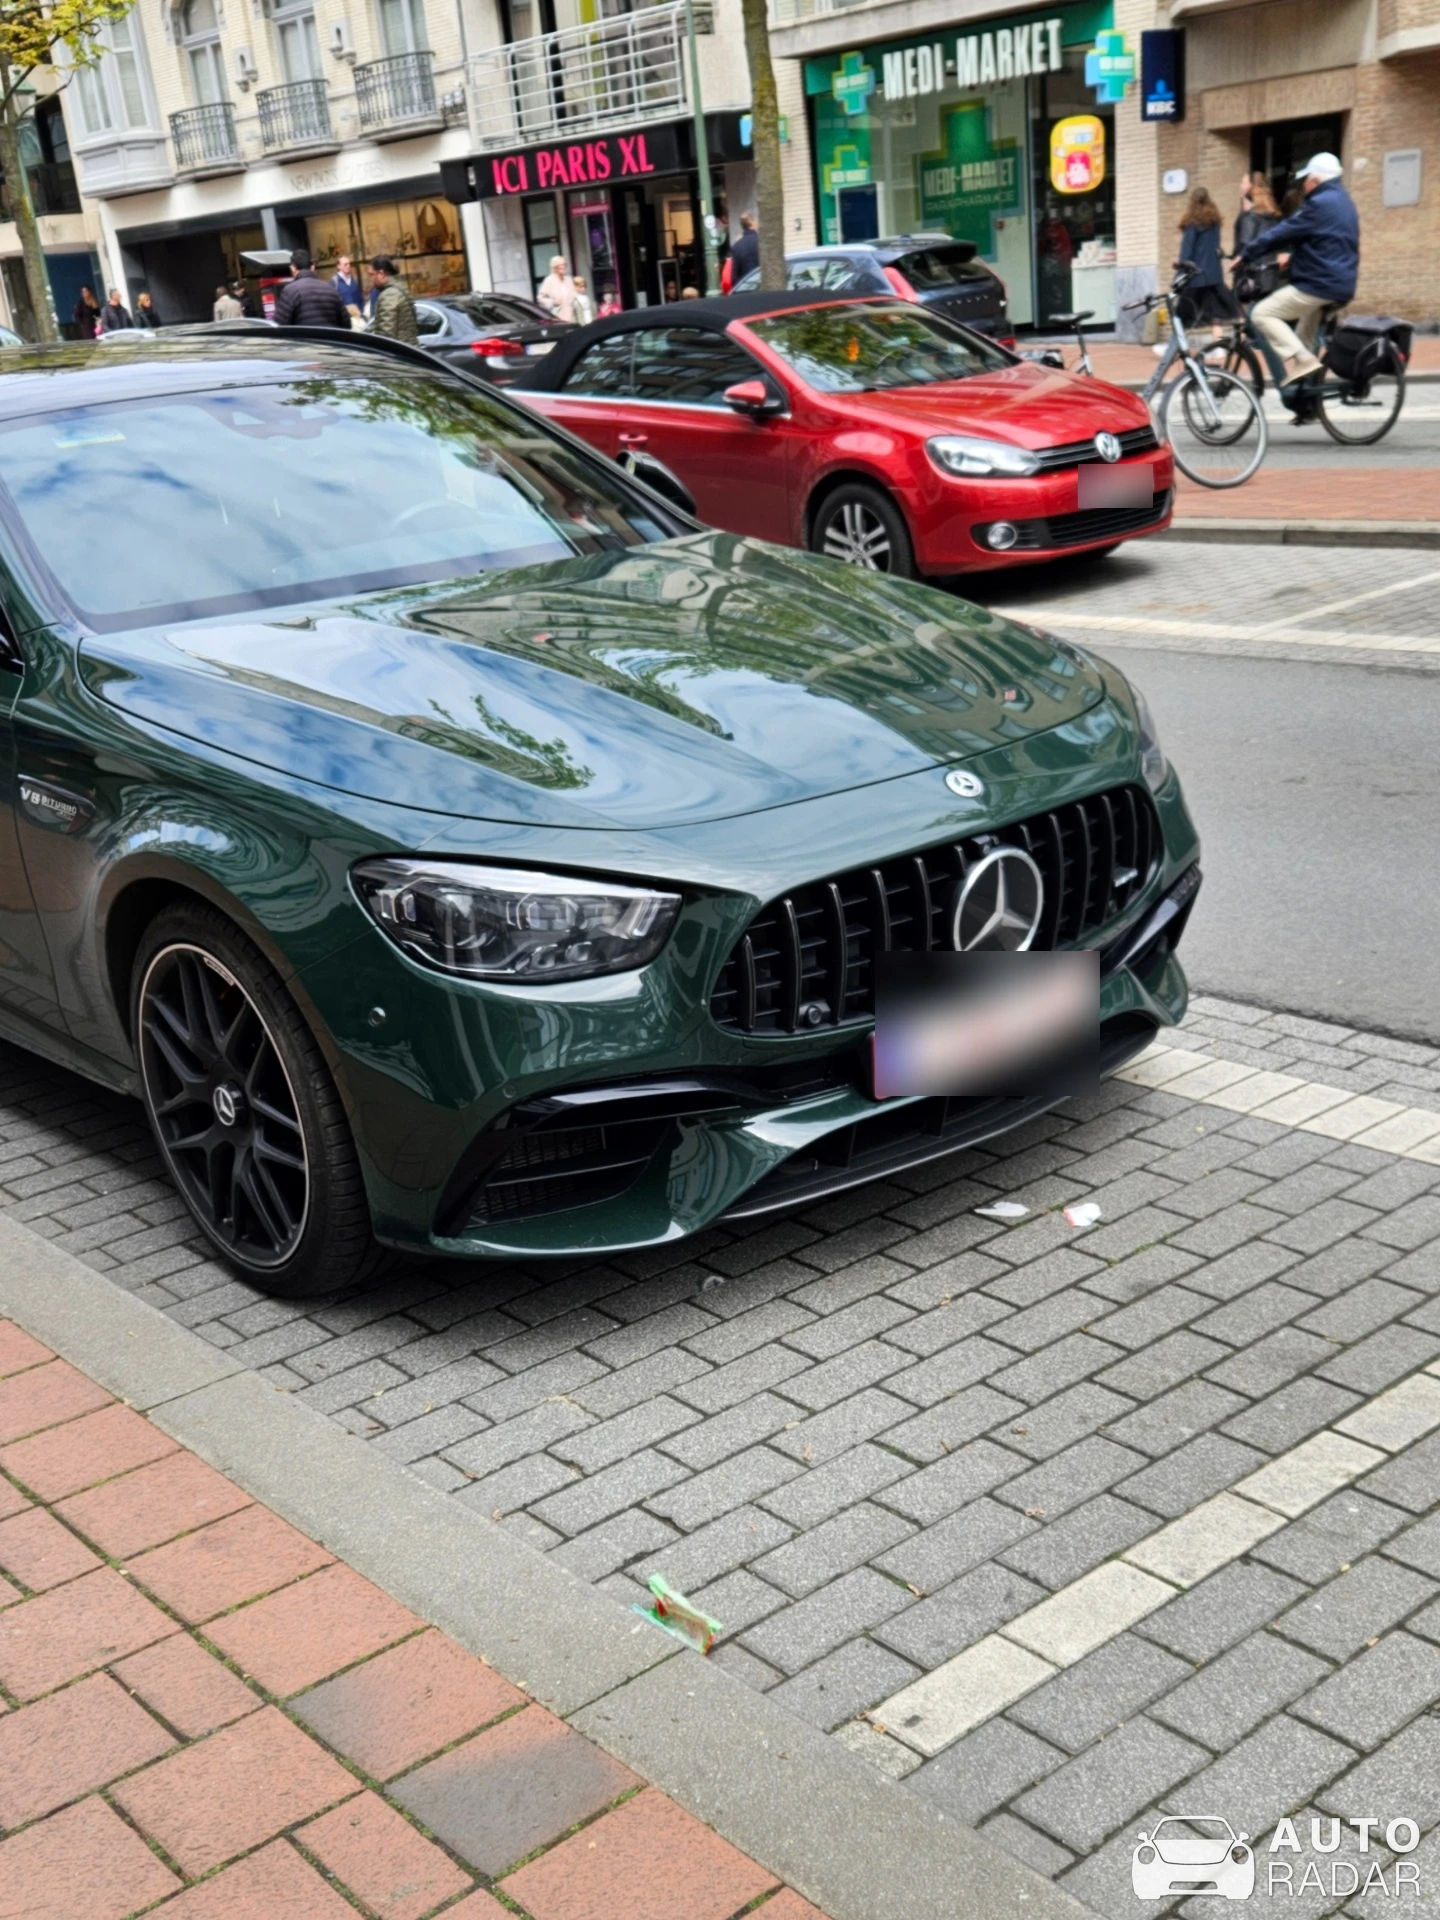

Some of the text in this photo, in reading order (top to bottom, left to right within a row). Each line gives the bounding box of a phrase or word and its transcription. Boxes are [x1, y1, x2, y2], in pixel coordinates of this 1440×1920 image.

[882, 18, 1063, 101] MEDI-MARKET
[1146, 100, 1175, 116] KBC
[492, 134, 655, 194] ICI PARIS XL
[20, 786, 41, 805] V8
[41, 795, 77, 816] BITURBO
